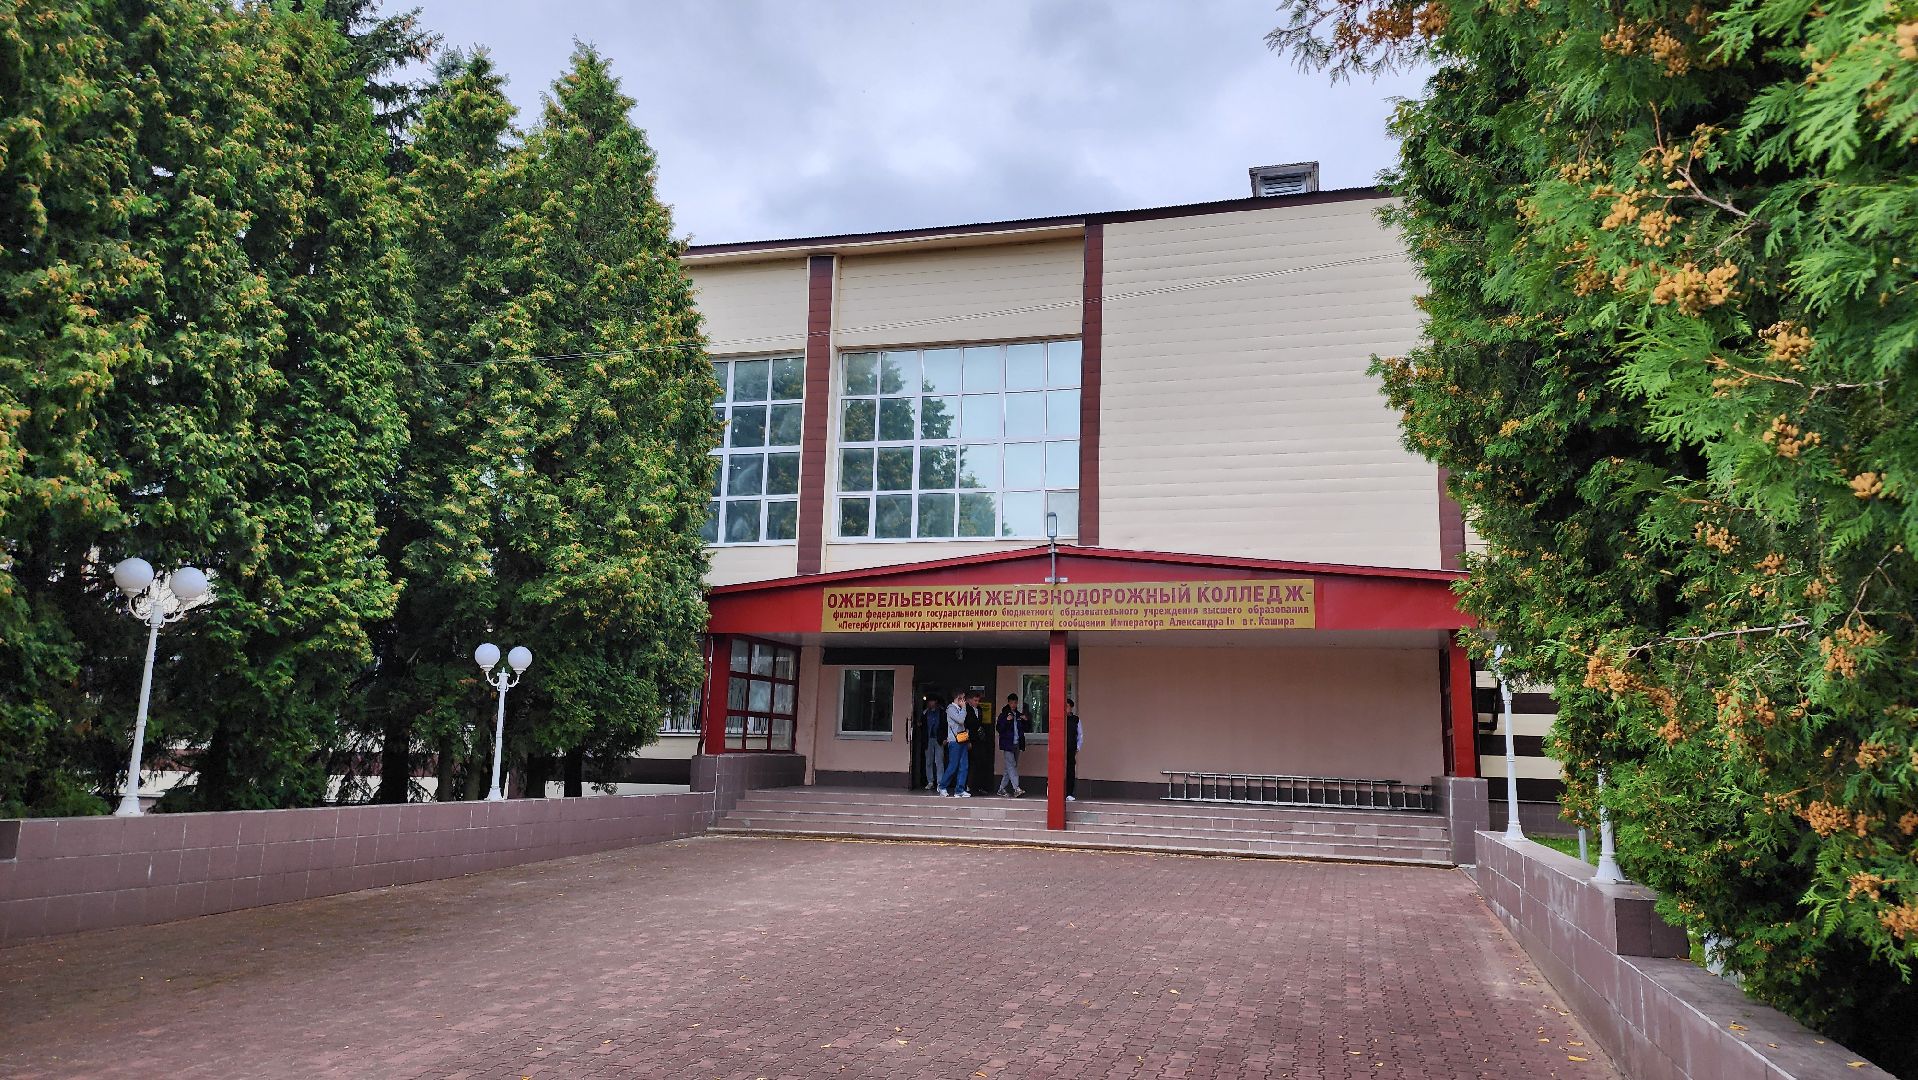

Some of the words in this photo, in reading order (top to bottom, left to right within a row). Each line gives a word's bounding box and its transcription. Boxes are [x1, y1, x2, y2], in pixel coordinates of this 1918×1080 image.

[827, 586, 981, 608] ОЖЕРЕЛЬЕВСКИЙ
[985, 583, 1191, 607] ЖЕЛЕЗНОДОРОЖНЫЙ
[1197, 585, 1312, 605] КОЛЛЕДЖ-
[832, 610, 863, 621] филиал
[865, 609, 923, 620] федерального
[926, 608, 997, 620] государственного
[1001, 607, 1053, 618] бюджетного
[1060, 606, 1139, 618] образовательного
[1143, 606, 1198, 617] учреждения
[1203, 606, 1242, 614] высшего
[1248, 604, 1309, 616] образования
[838, 620, 901, 631] «Петербургский
[903, 619, 973, 630] государственный
[976, 620, 1027, 630] университет
[1030, 618, 1054, 629] путей
[1058, 618, 1106, 628] сообщения
[1110, 618, 1164, 629] Императора
[1169, 617, 1224, 629] Александра
[1258, 616, 1295, 627] Кашира
